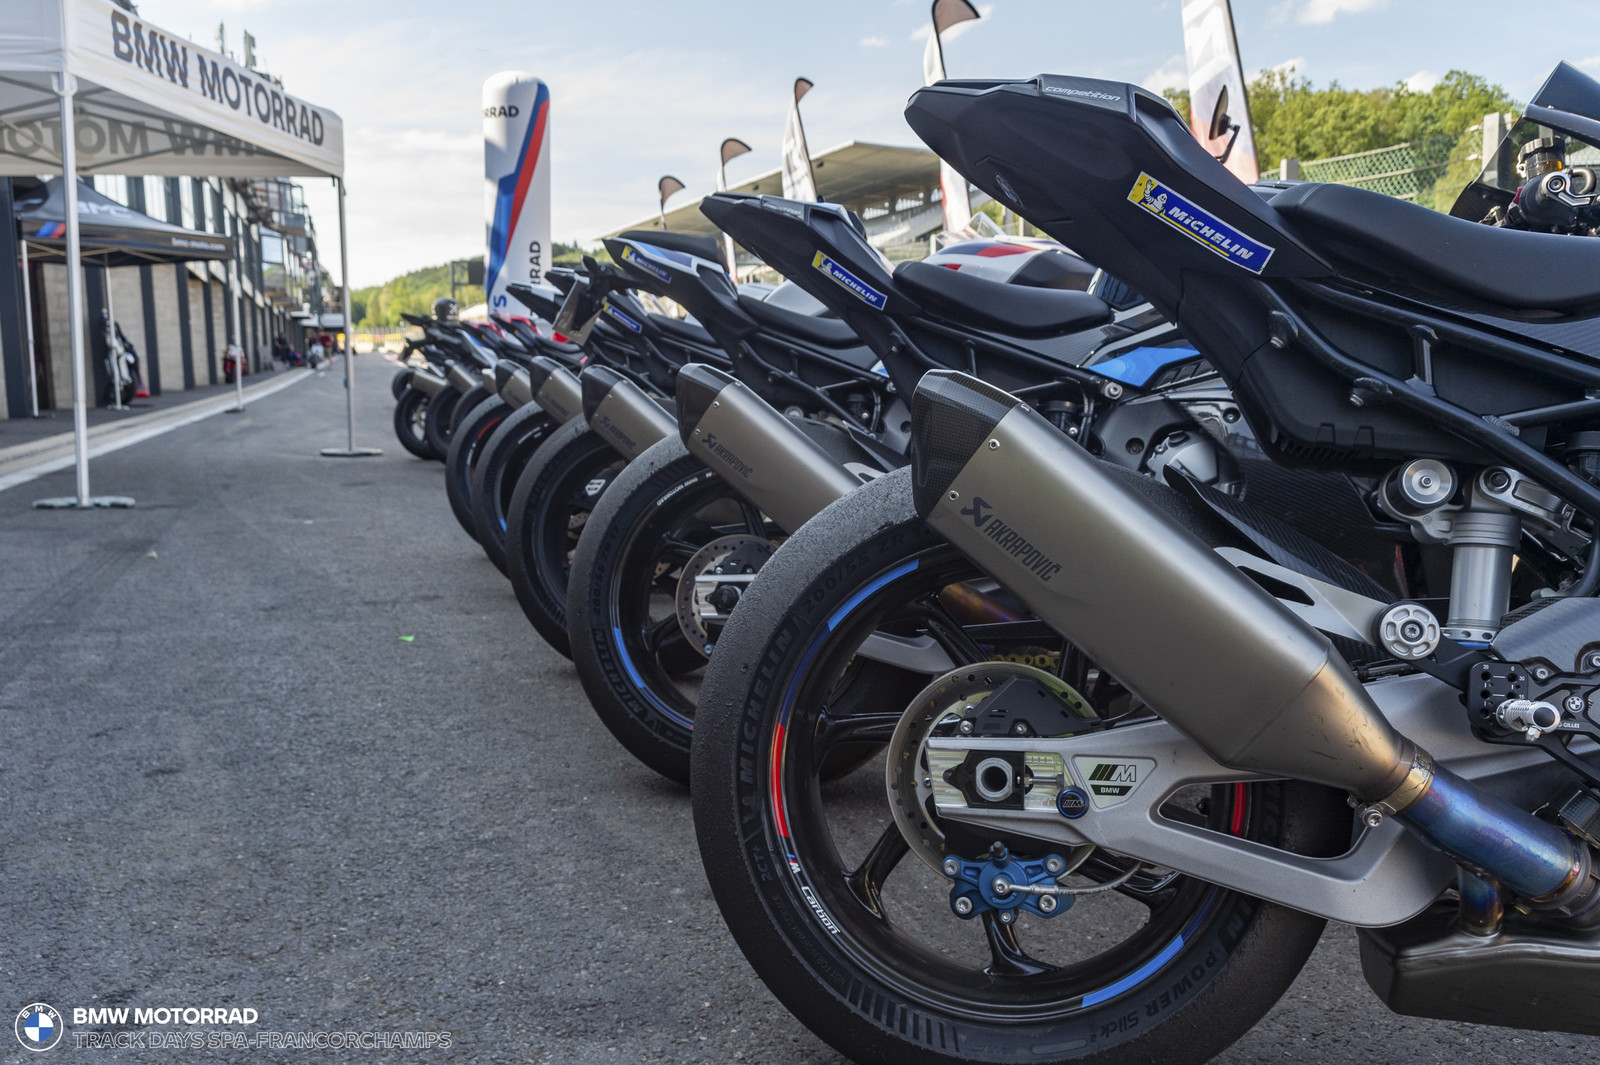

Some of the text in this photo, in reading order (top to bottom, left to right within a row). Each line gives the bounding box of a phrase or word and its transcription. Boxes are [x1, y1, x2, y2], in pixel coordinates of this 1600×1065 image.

[111, 11, 324, 146] BMW MOTORRAD
[1045, 86, 1121, 102] competition
[1168, 206, 1254, 261] MICHELIN
[833, 270, 878, 302] MICHELIN
[594, 630, 643, 713] MICHELIN
[739, 627, 793, 784] MICHELIN
[801, 886, 841, 935] Carbon
[1145, 950, 1219, 1018] POWER
